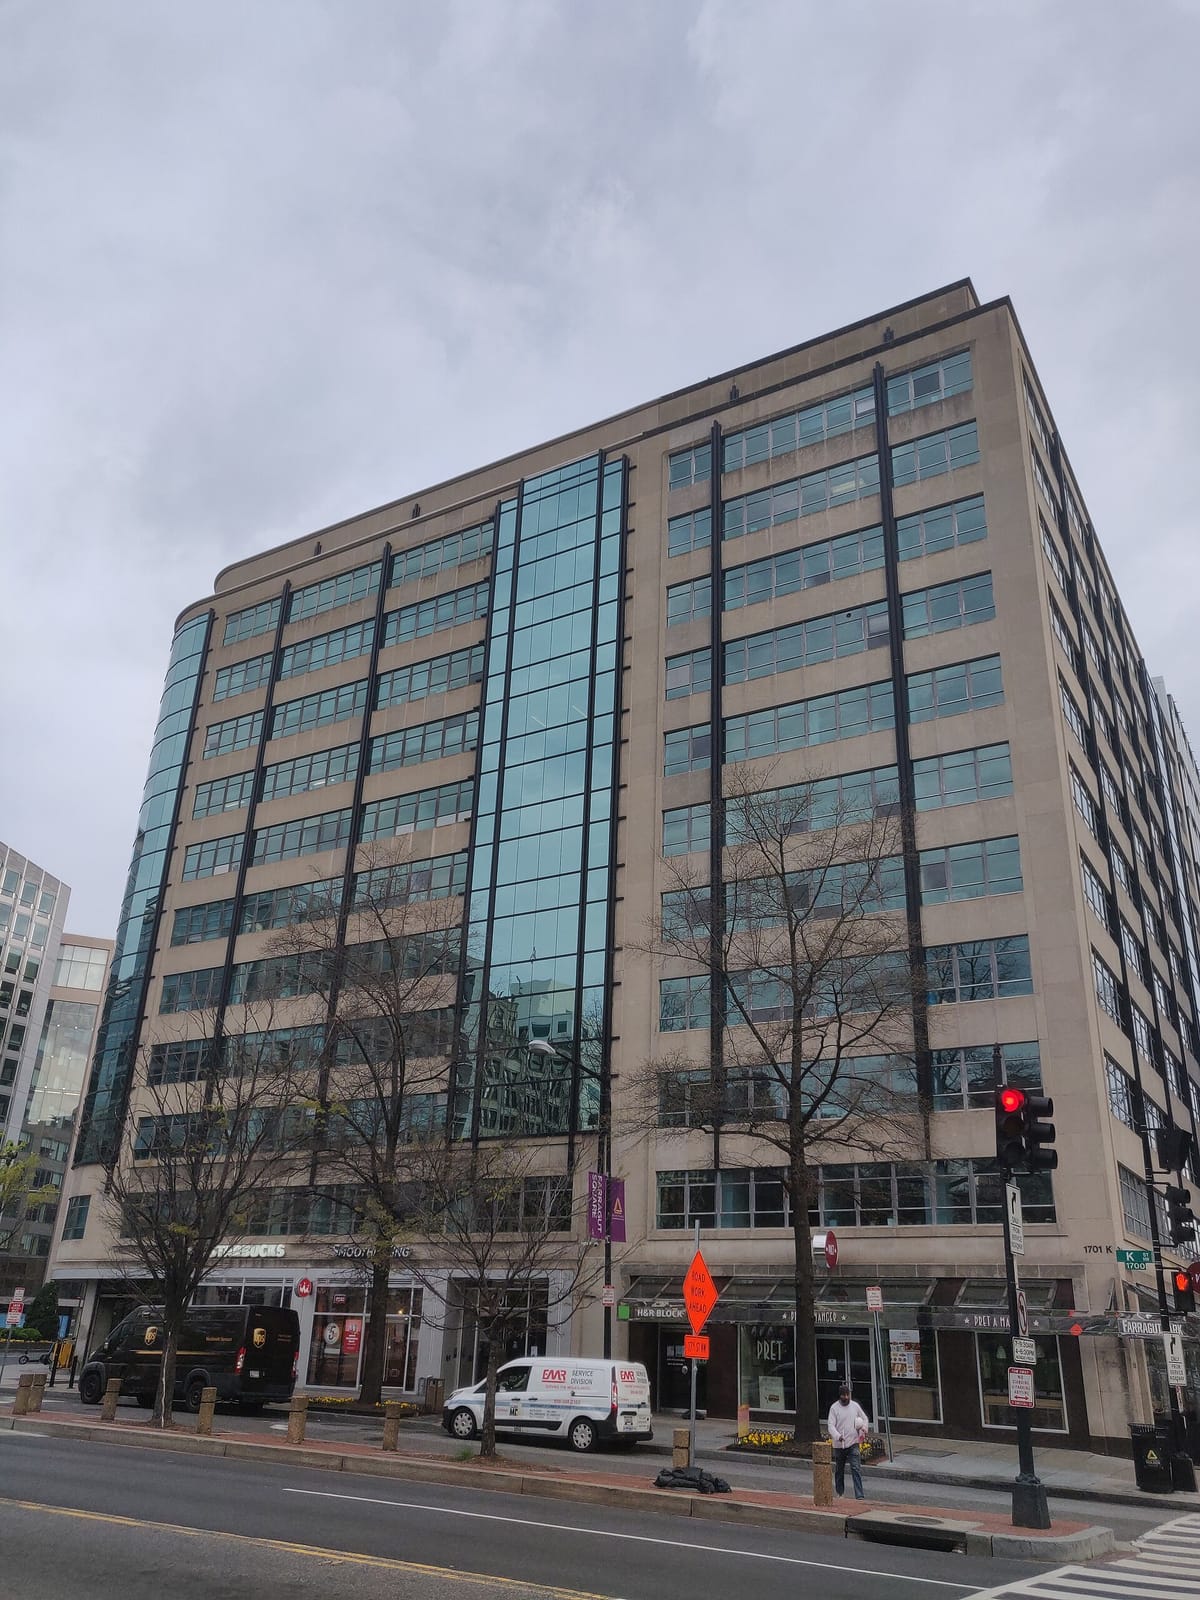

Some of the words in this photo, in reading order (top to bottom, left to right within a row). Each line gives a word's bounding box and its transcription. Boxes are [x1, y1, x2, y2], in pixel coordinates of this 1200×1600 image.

[209, 1244, 286, 1258] STARBUCKS
[333, 1244, 381, 1258] SMOOTHI
[1083, 1245, 1103, 1254] 1701
[1105, 1245, 1113, 1254] K
[1125, 1251, 1135, 1262] K
[1126, 1262, 1146, 1270] 1700
[691, 1271, 706, 1283] ROAD
[690, 1287, 705, 1297] WORK
[637, 1308, 655, 1317] H&R
[656, 1308, 683, 1318] BLOCK
[689, 1303, 707, 1314] AHEAD
[974, 1315, 990, 1327] PRET
[992, 1317, 998, 1328] A
[1122, 1319, 1161, 1334] FARRAGUT
[756, 1340, 783, 1361] PRET
